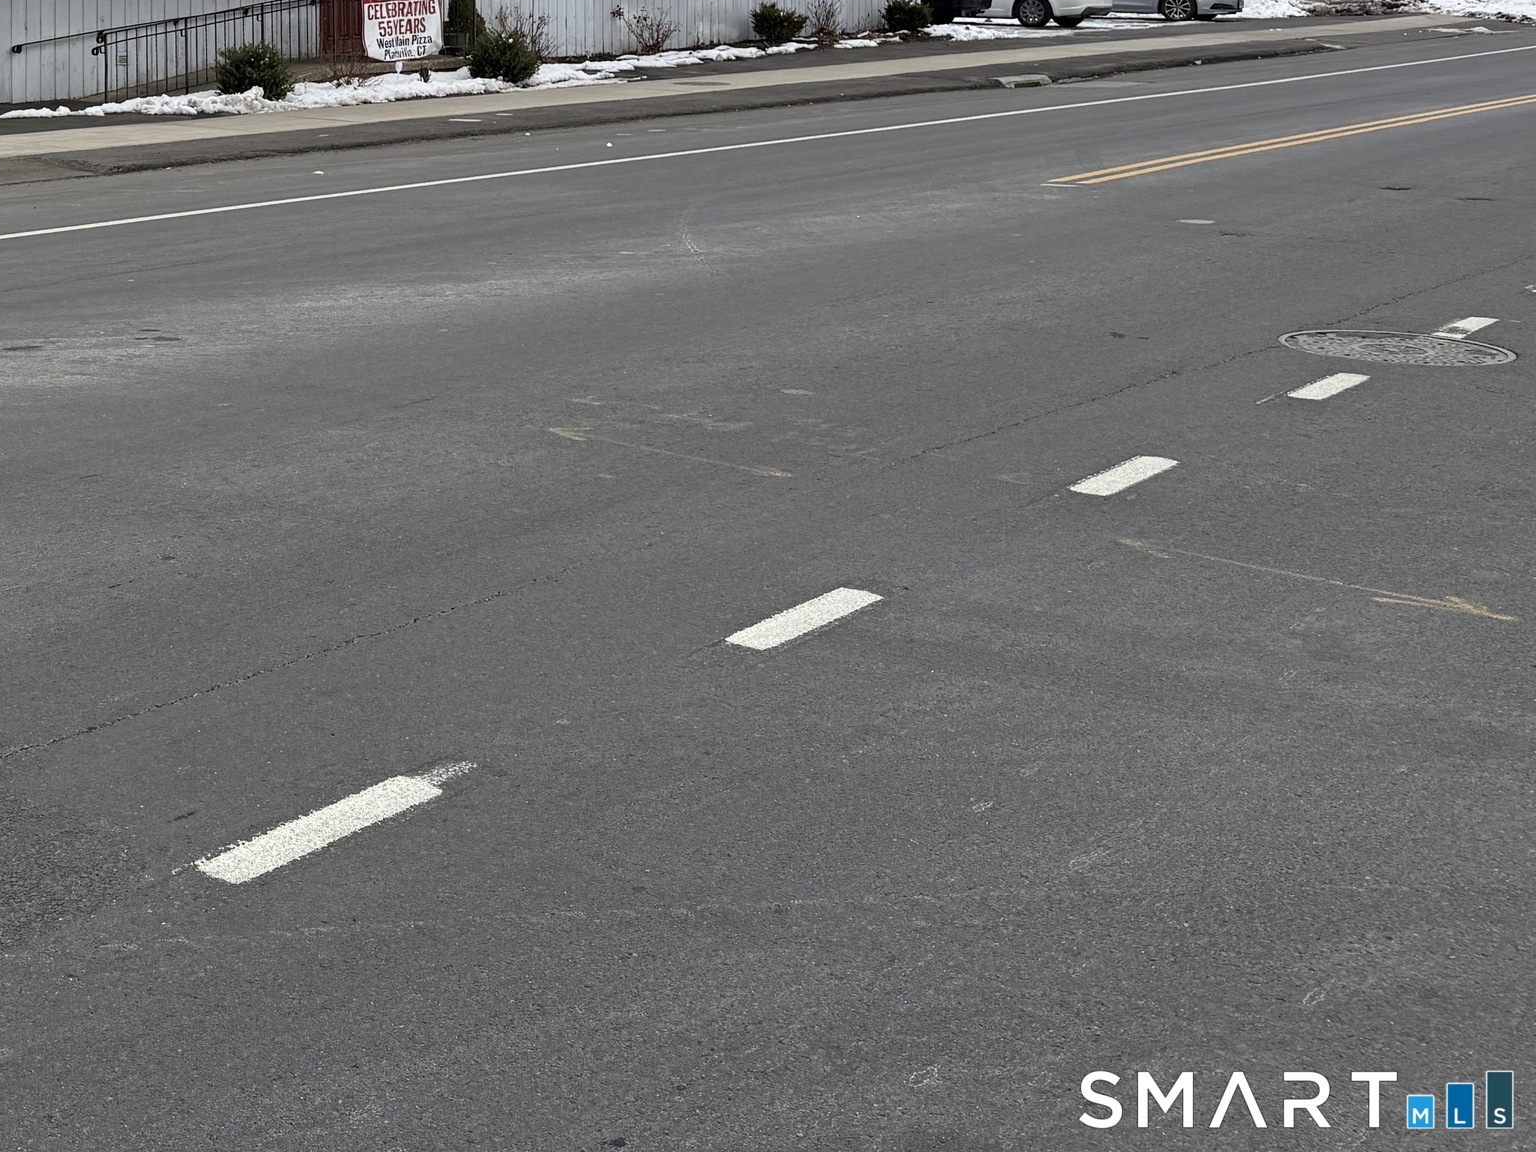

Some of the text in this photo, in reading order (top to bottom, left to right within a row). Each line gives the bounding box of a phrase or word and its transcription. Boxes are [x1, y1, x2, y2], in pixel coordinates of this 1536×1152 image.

[367, 0, 436, 20] CELEBRATING
[376, 38, 395, 49] West
[411, 35, 432, 45] Pizza
